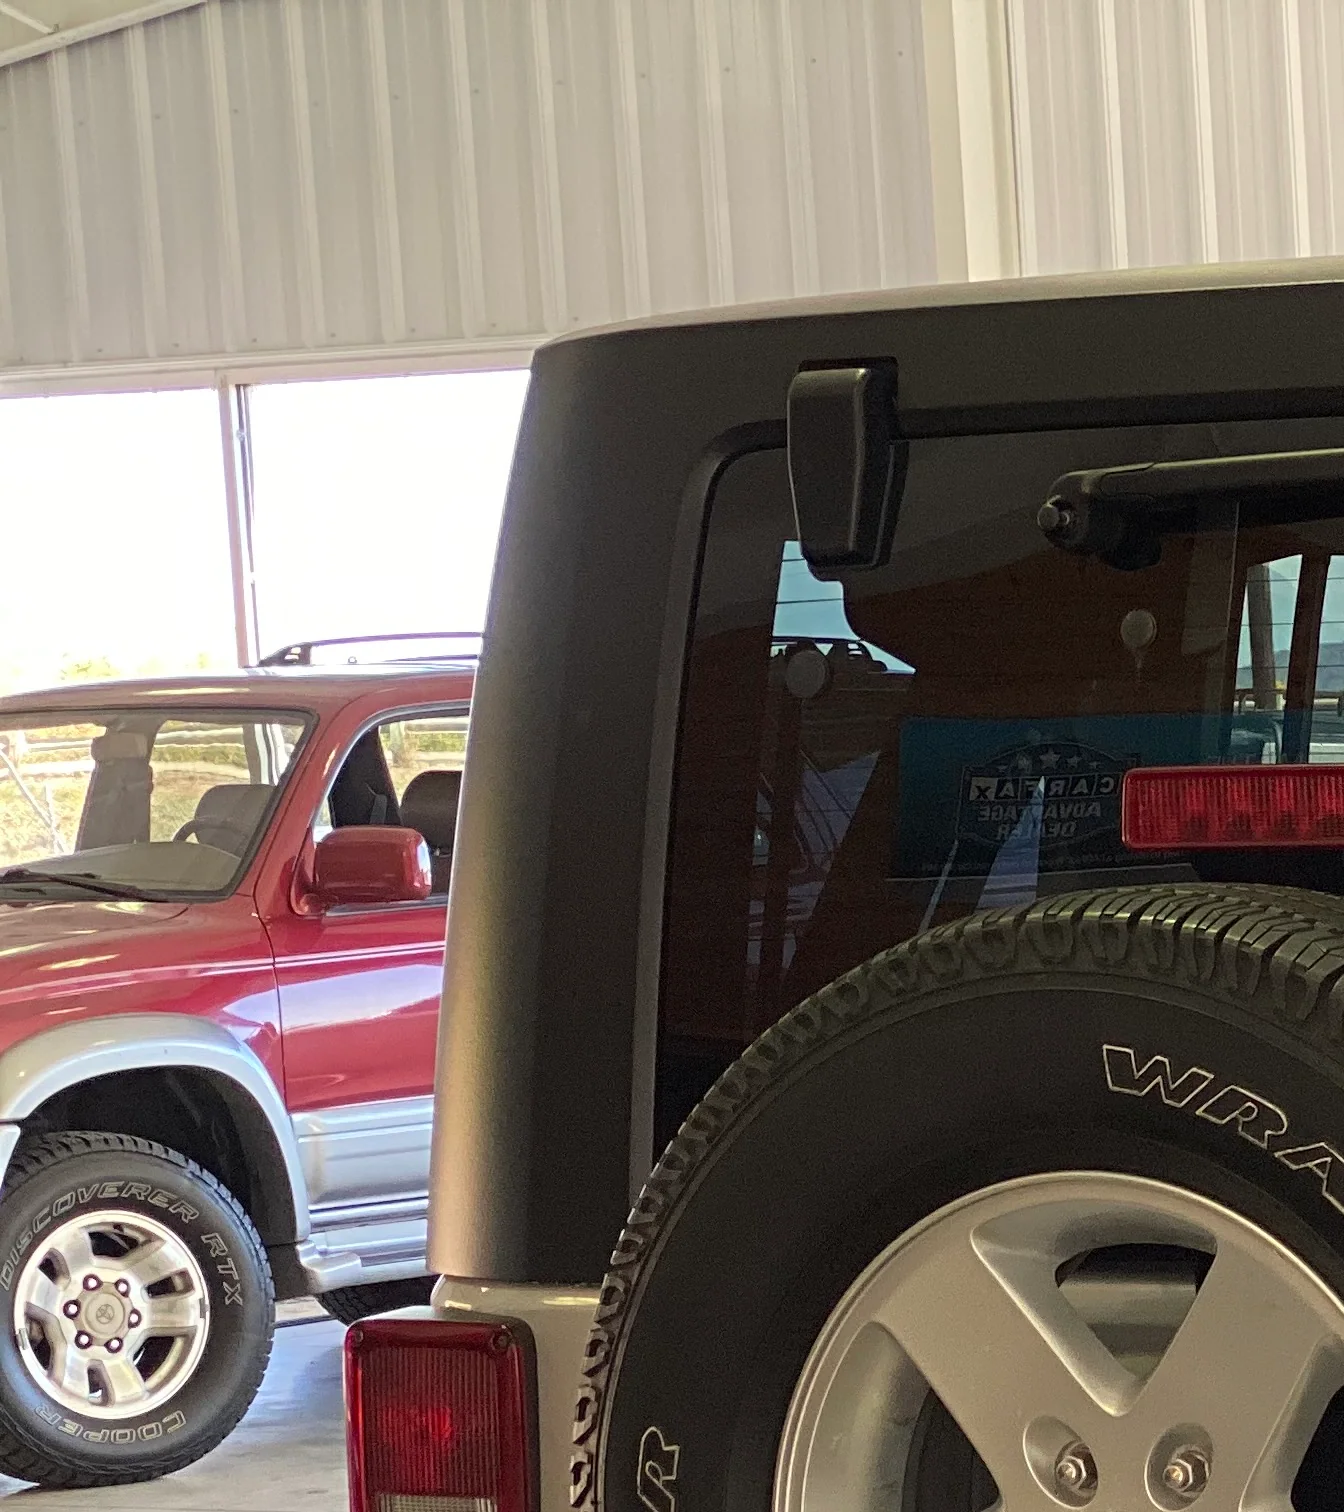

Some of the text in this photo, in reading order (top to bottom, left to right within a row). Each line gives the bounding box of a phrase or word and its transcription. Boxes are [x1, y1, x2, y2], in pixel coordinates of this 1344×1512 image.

[0, 1180, 243, 1306] DISCOVERER RTX
[35, 1404, 187, 1444] COOPER
